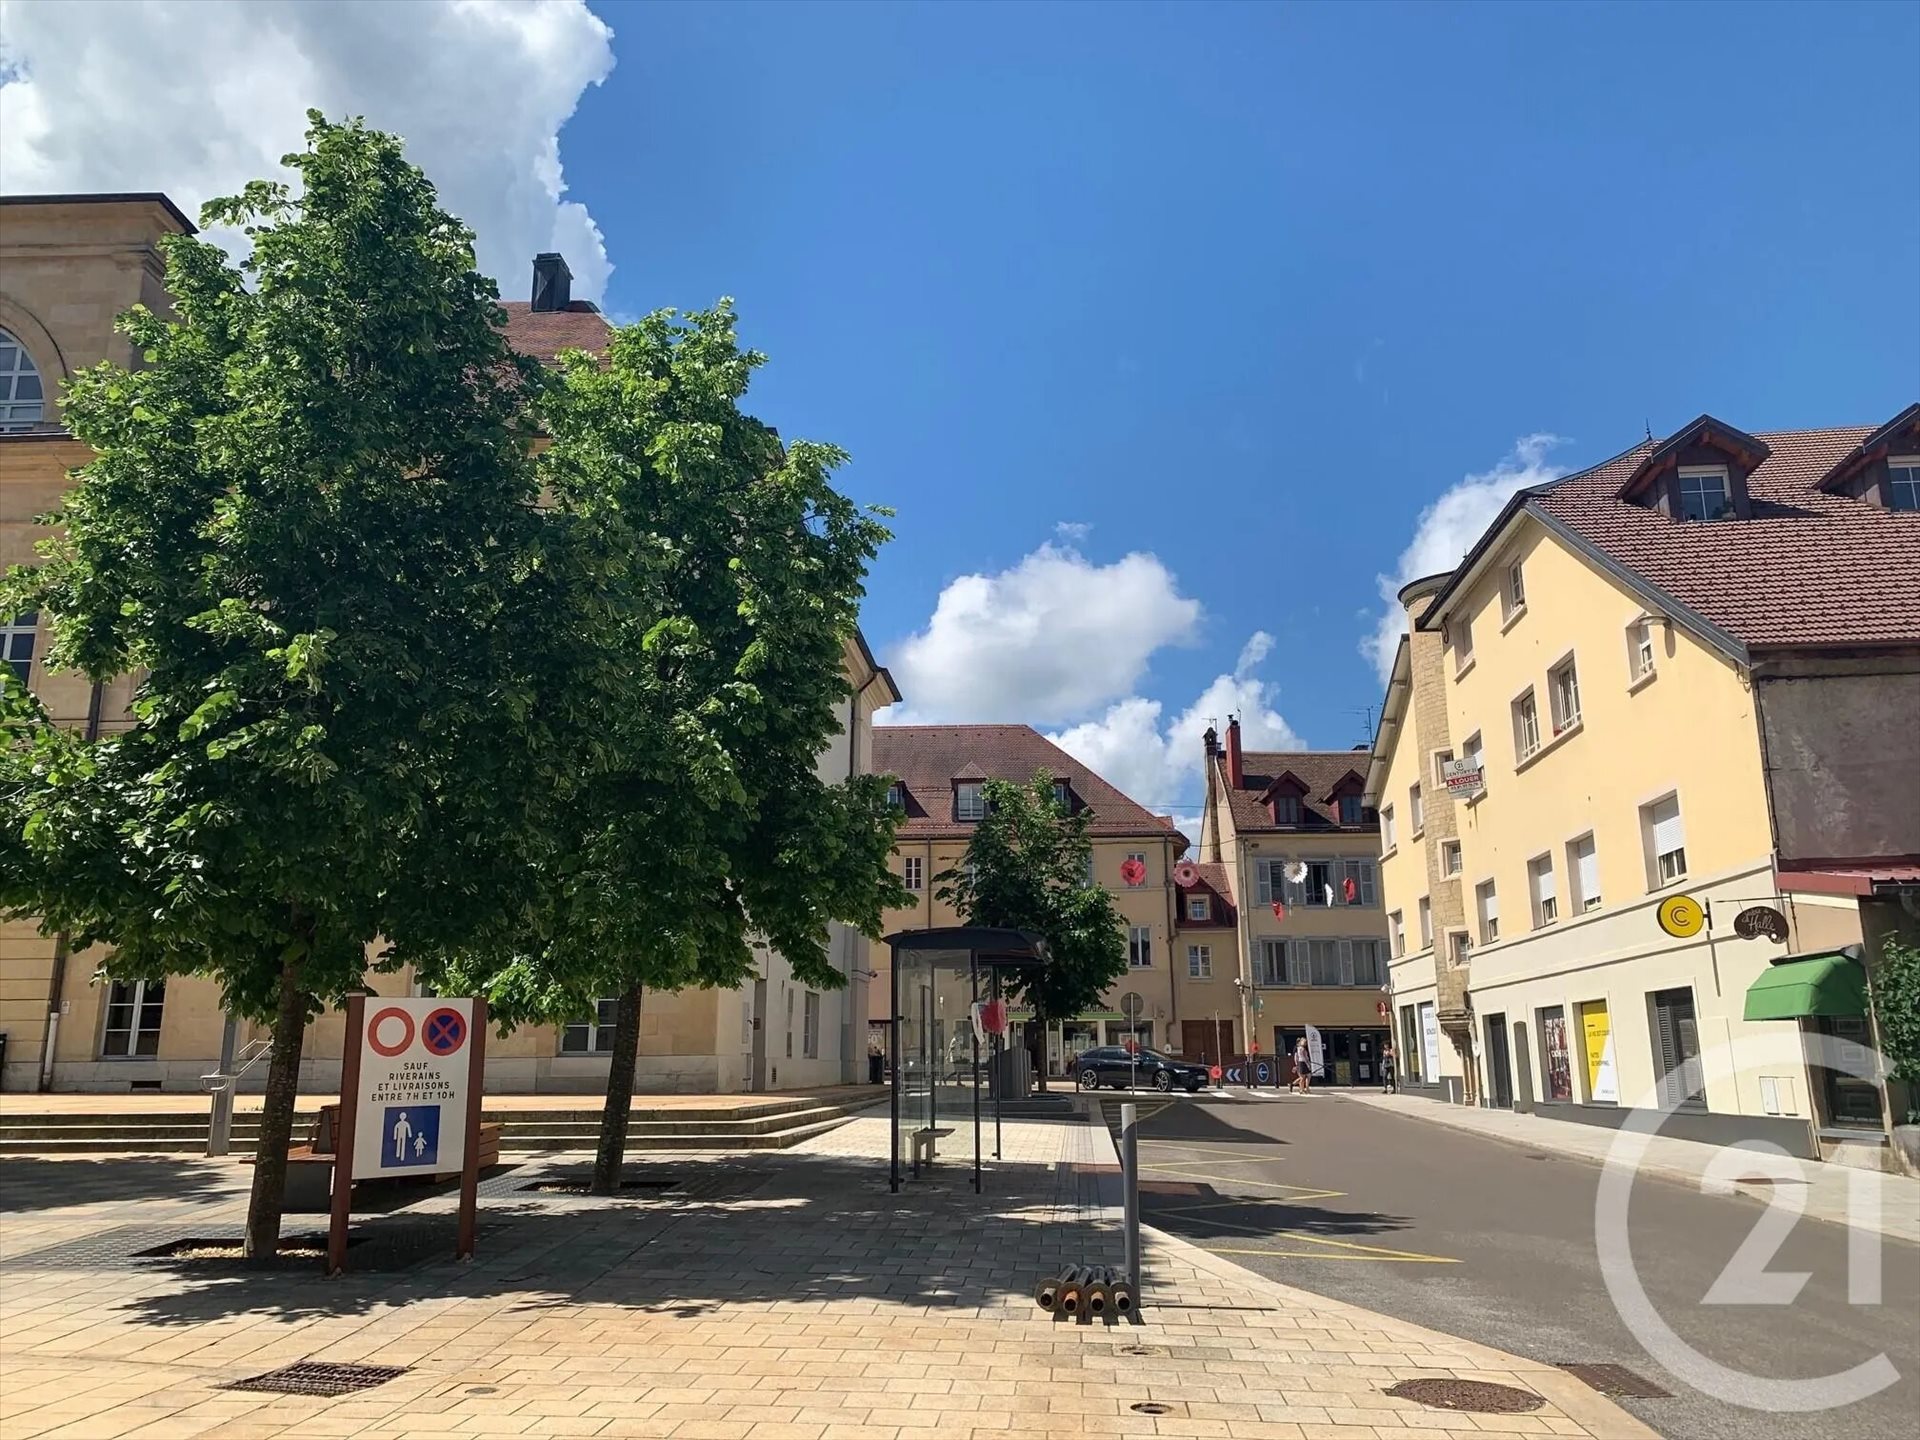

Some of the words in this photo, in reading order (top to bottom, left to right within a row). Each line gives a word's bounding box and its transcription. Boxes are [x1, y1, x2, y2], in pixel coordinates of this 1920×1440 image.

[1447, 769, 1470, 777] CENTURY
[1454, 775, 1479, 785] LOUER
[1748, 914, 1776, 932] Halle
[403, 1062, 429, 1071] SAUF
[388, 1072, 441, 1081] RIVERAINS
[378, 1083, 389, 1091] ET
[393, 1081, 450, 1091] LIVRAISONS
[371, 1092, 402, 1101] ENTRE
[422, 1091, 433, 1100] ET
[437, 1090, 455, 1099] 10H
